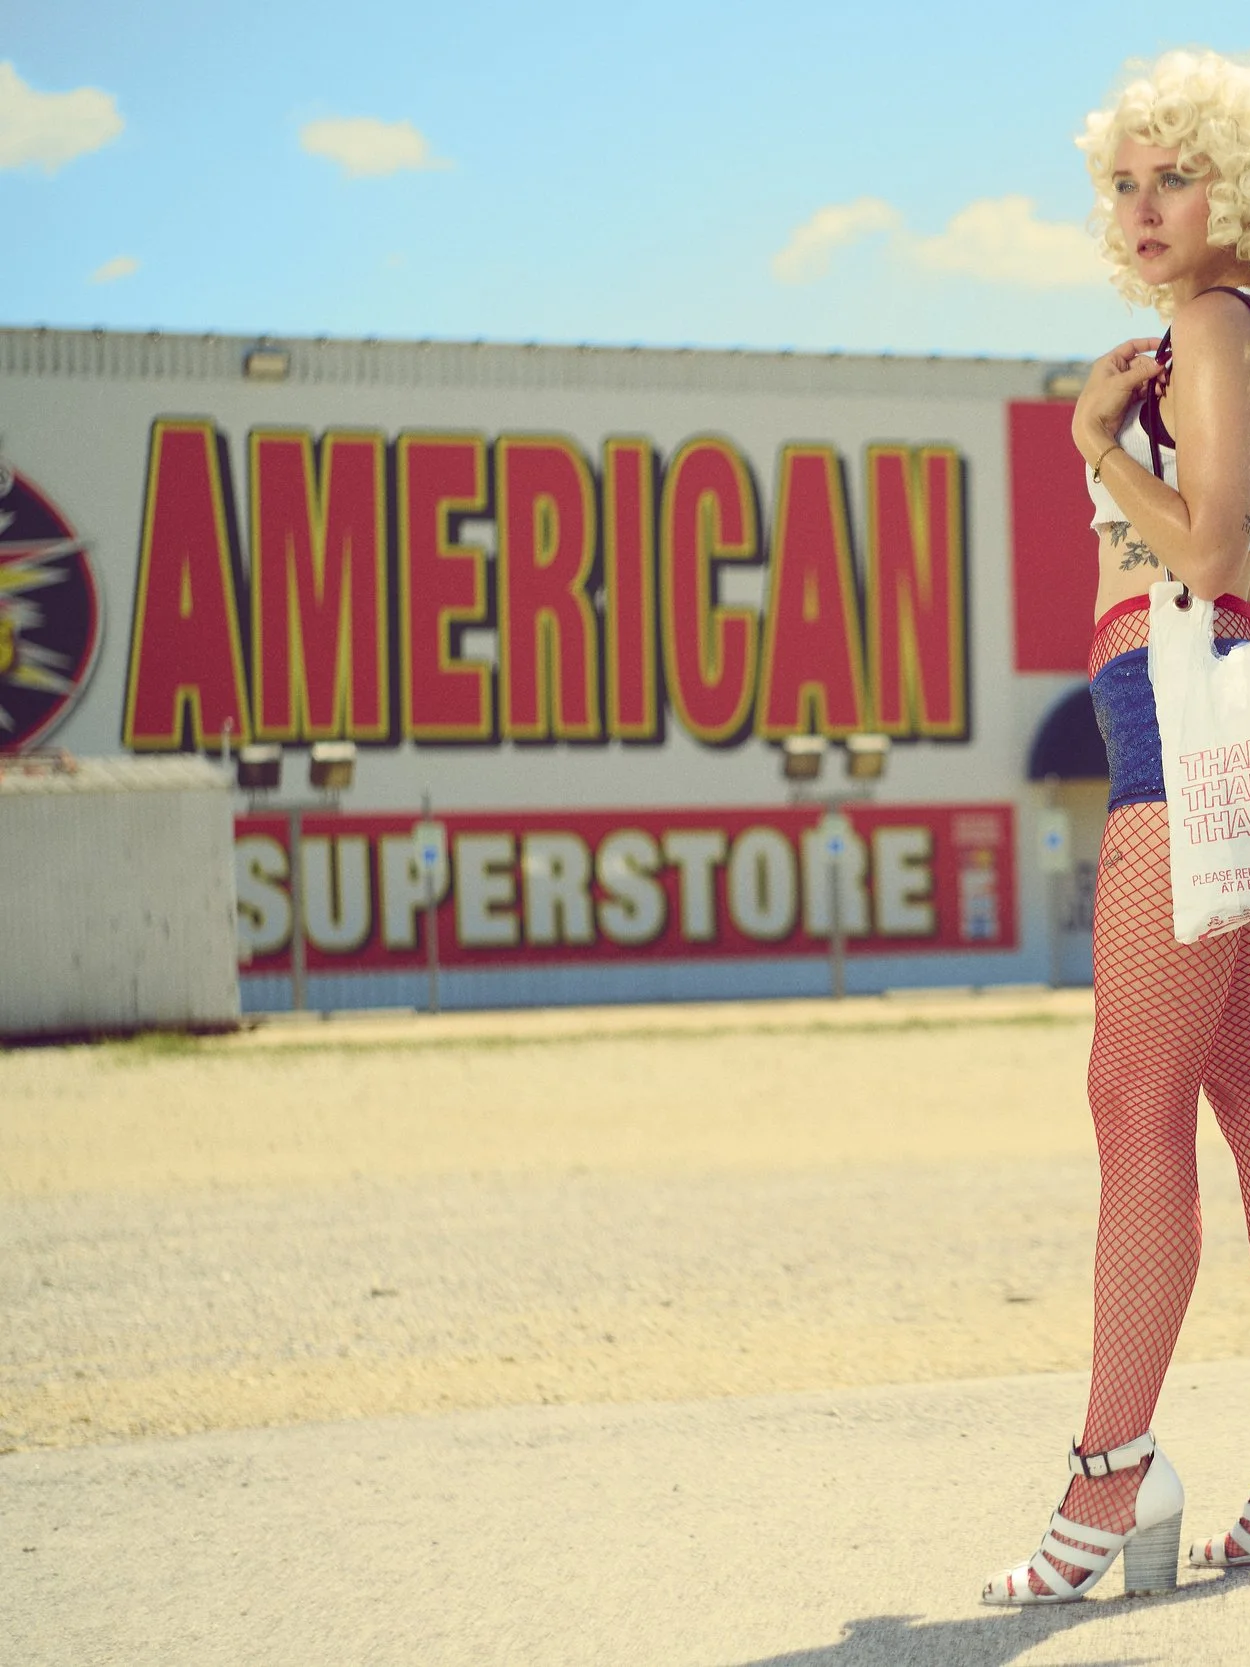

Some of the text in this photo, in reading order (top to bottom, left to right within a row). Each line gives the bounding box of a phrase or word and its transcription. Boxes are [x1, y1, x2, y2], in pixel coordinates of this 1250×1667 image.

[123, 418, 970, 748] AMERICAN
[236, 826, 936, 956] SUPERSTORE
[1192, 868, 1232, 886] PLEASE
[1221, 881, 1235, 894] AT
[1236, 880, 1245, 892] A
